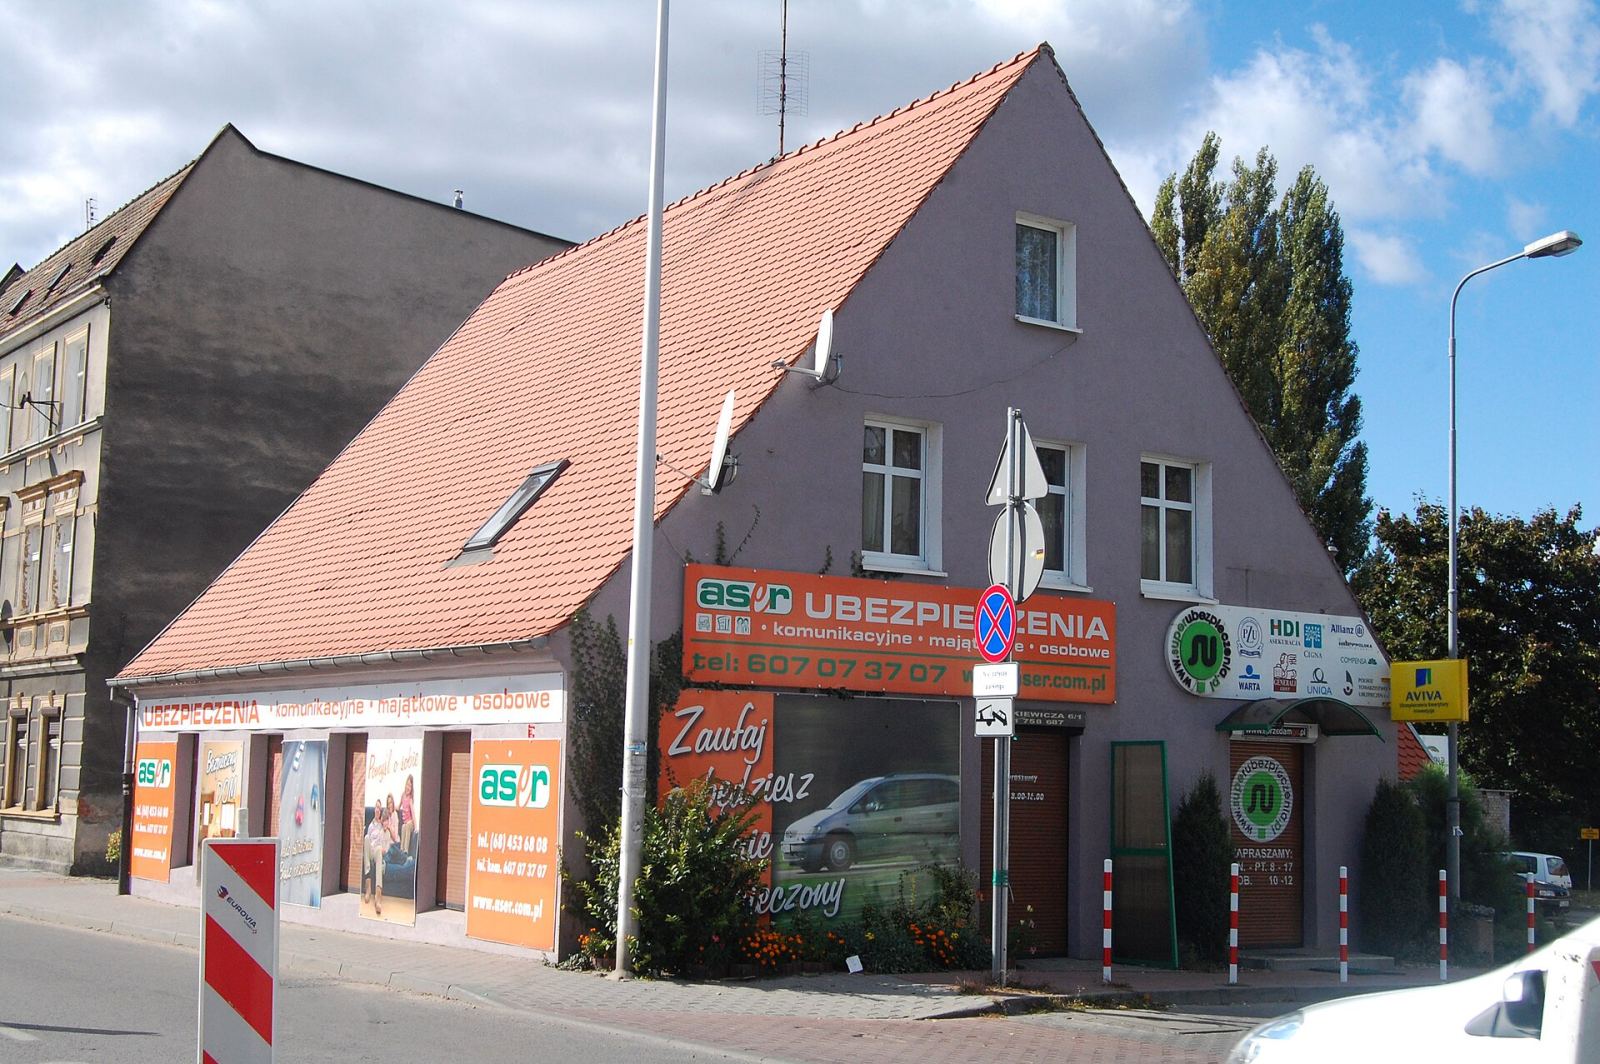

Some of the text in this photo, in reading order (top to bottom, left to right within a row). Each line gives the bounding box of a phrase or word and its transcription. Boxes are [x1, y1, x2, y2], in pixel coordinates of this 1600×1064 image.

[1270, 618, 1300, 638] HDI
[1330, 624, 1355, 635] Allianz
[773, 621, 1111, 659] komunikacyjne mająte osobowe
[1303, 650, 1323, 659] CIGNA
[692, 652, 740, 673] tel:
[747, 653, 811, 676] 607
[817, 657, 857, 678] 07
[864, 660, 902, 681] 37
[909, 663, 948, 684] 07
[1238, 681, 1261, 691] WARTA
[1306, 685, 1333, 695] UNIQA
[1405, 690, 1442, 701] AVIVA
[144, 688, 550, 727] UBEZPIECZENIA komunikacyjne majątkowe osobowe
[668, 702, 768, 765] Zaufaj
[478, 831, 548, 854] tel. (68) 453 68 08
[226, 896, 257, 928] EUROVIA
[473, 895, 543, 923] www.aser.com.pl
